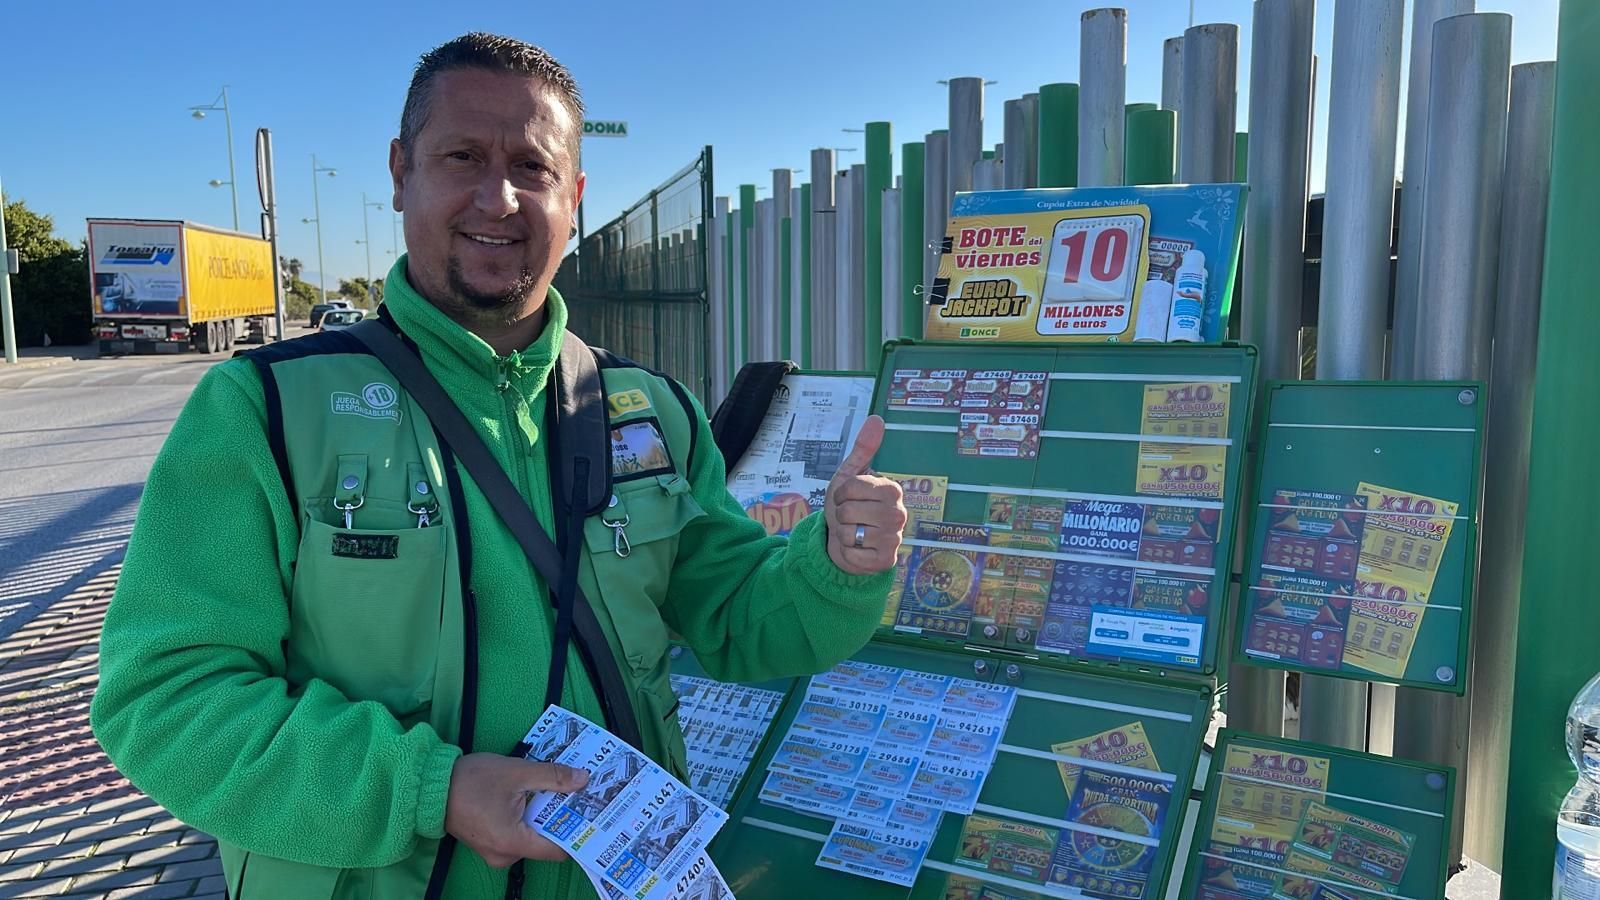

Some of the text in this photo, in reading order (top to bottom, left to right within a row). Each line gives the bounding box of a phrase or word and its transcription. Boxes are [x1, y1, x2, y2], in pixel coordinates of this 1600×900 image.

[1036, 198, 1140, 209] Cupón Extra de Navidad
[959, 227, 1043, 249] BOTE del
[955, 250, 1041, 269] viernes
[1061, 226, 1129, 284] 10
[962, 280, 1010, 299] EURO
[940, 296, 1027, 318] JACKPOT
[1044, 304, 1125, 319] MILLONES
[971, 328, 998, 336] ONCE
[1054, 319, 1107, 329] de euros
[336, 397, 360, 405] JUEGA
[1166, 385, 1212, 402] x10
[765, 474, 792, 485] Triplex
[1160, 464, 1208, 481] x10
[1085, 501, 1122, 515] Mega
[1379, 494, 1436, 519] x10
[1062, 513, 1141, 533] MILLONARIO
[1060, 535, 1138, 551] 1.000.000€
[1252, 753, 1309, 776] x10
[640, 782, 677, 819] 51647
[577, 826, 596, 845] ONCE
[884, 834, 919, 848] 52369
[641, 875, 658, 894] ONCE
[676, 856, 706, 894] 47409
